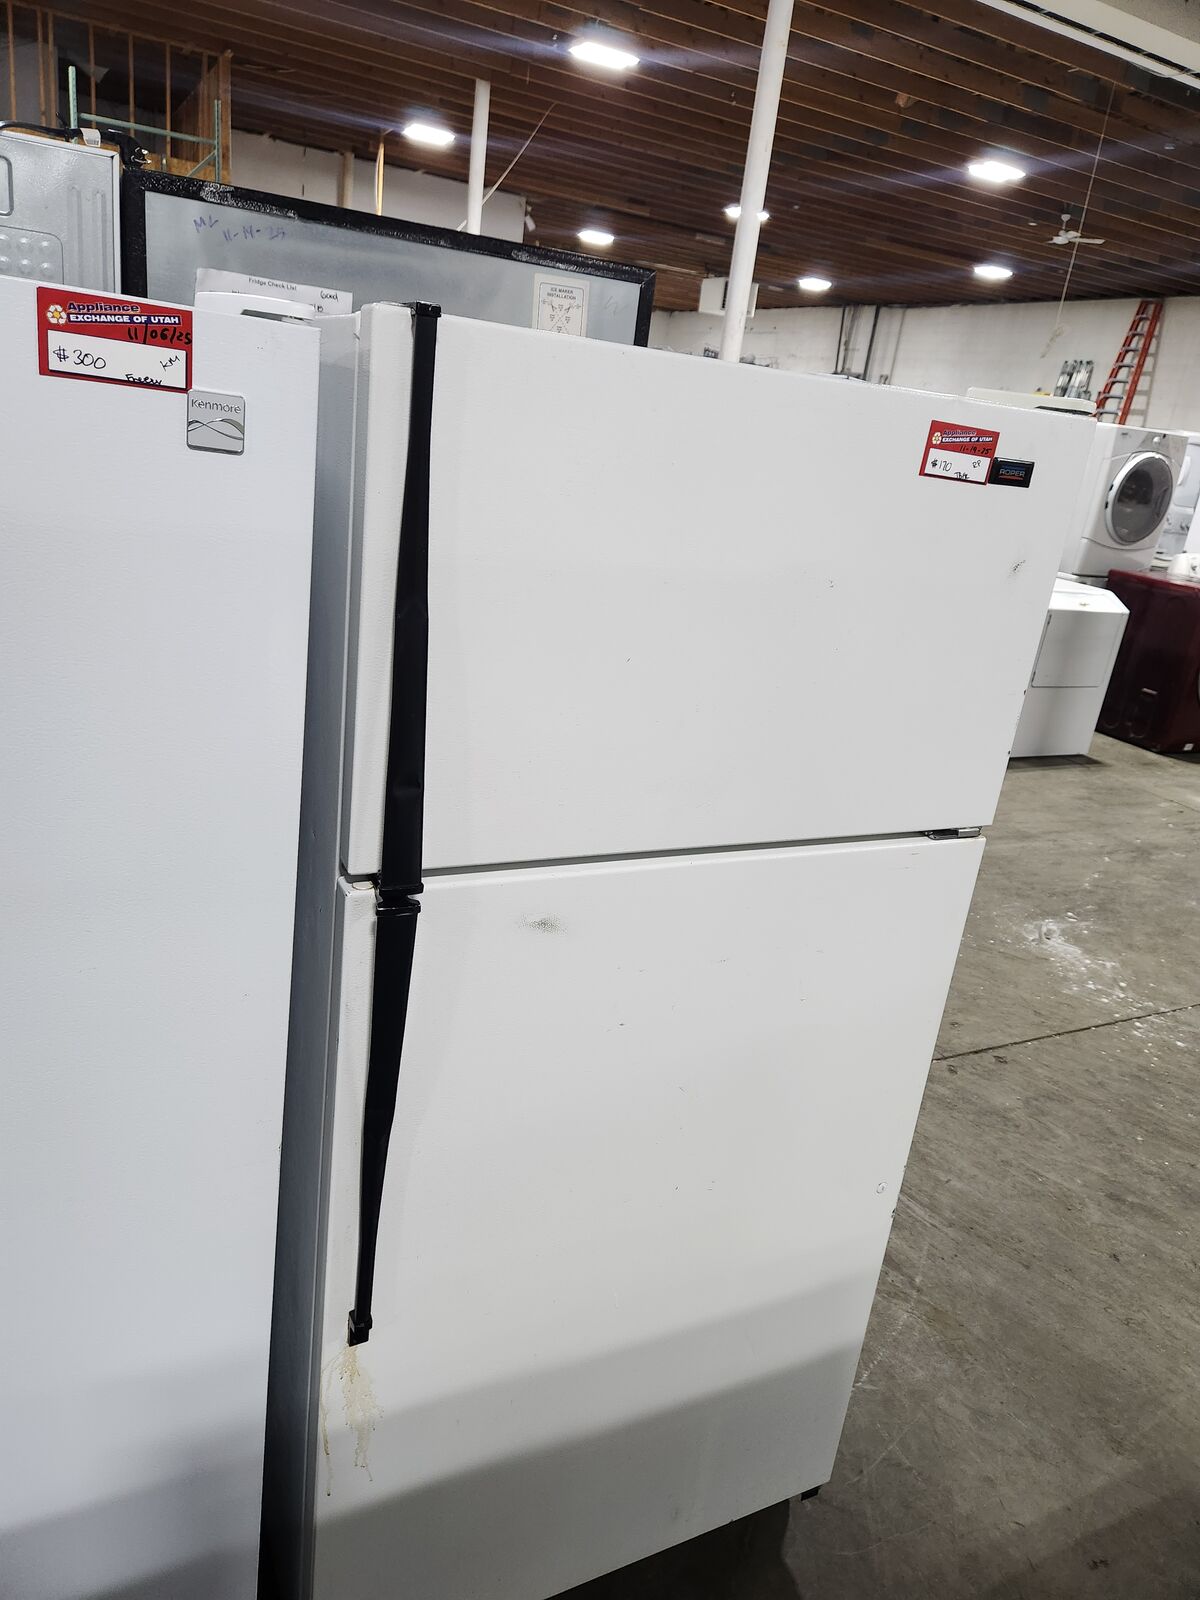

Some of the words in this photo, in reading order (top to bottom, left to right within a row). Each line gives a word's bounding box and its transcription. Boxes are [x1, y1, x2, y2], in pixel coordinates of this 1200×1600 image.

[248, 277, 267, 287] Fridge
[267, 281, 285, 289] Check
[67, 302, 140, 313] Appliance
[69, 314, 130, 323] EXCHANGE
[132, 315, 148, 323] OF
[150, 316, 179, 324] UTAH
[191, 399, 242, 414] Kenmore
[999, 468, 1026, 478] ROPER
